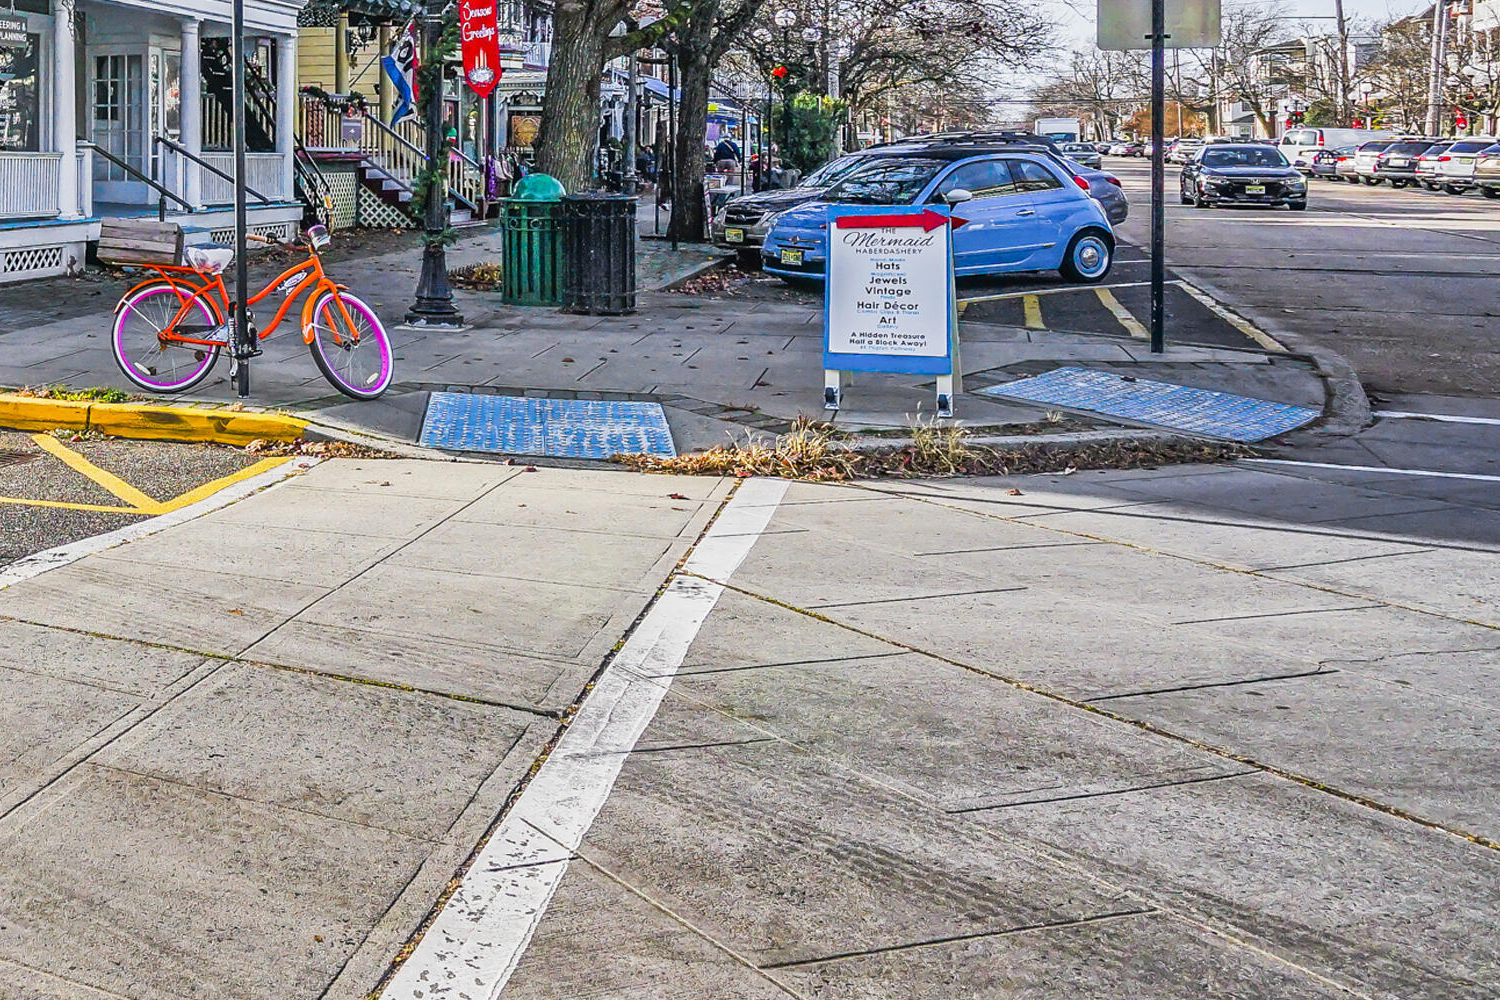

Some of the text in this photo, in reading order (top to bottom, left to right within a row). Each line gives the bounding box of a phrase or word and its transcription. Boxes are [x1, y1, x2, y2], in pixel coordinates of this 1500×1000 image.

[21, 22, 26, 31] &
[843, 231, 934, 248] Mermaid
[875, 262, 901, 270] Hats
[869, 276, 908, 285] Jewels
[865, 286, 912, 297] Vintage
[857, 301, 919, 310] Hair Décor
[879, 316, 897, 325] Art
[900, 340, 927, 348] Away!
